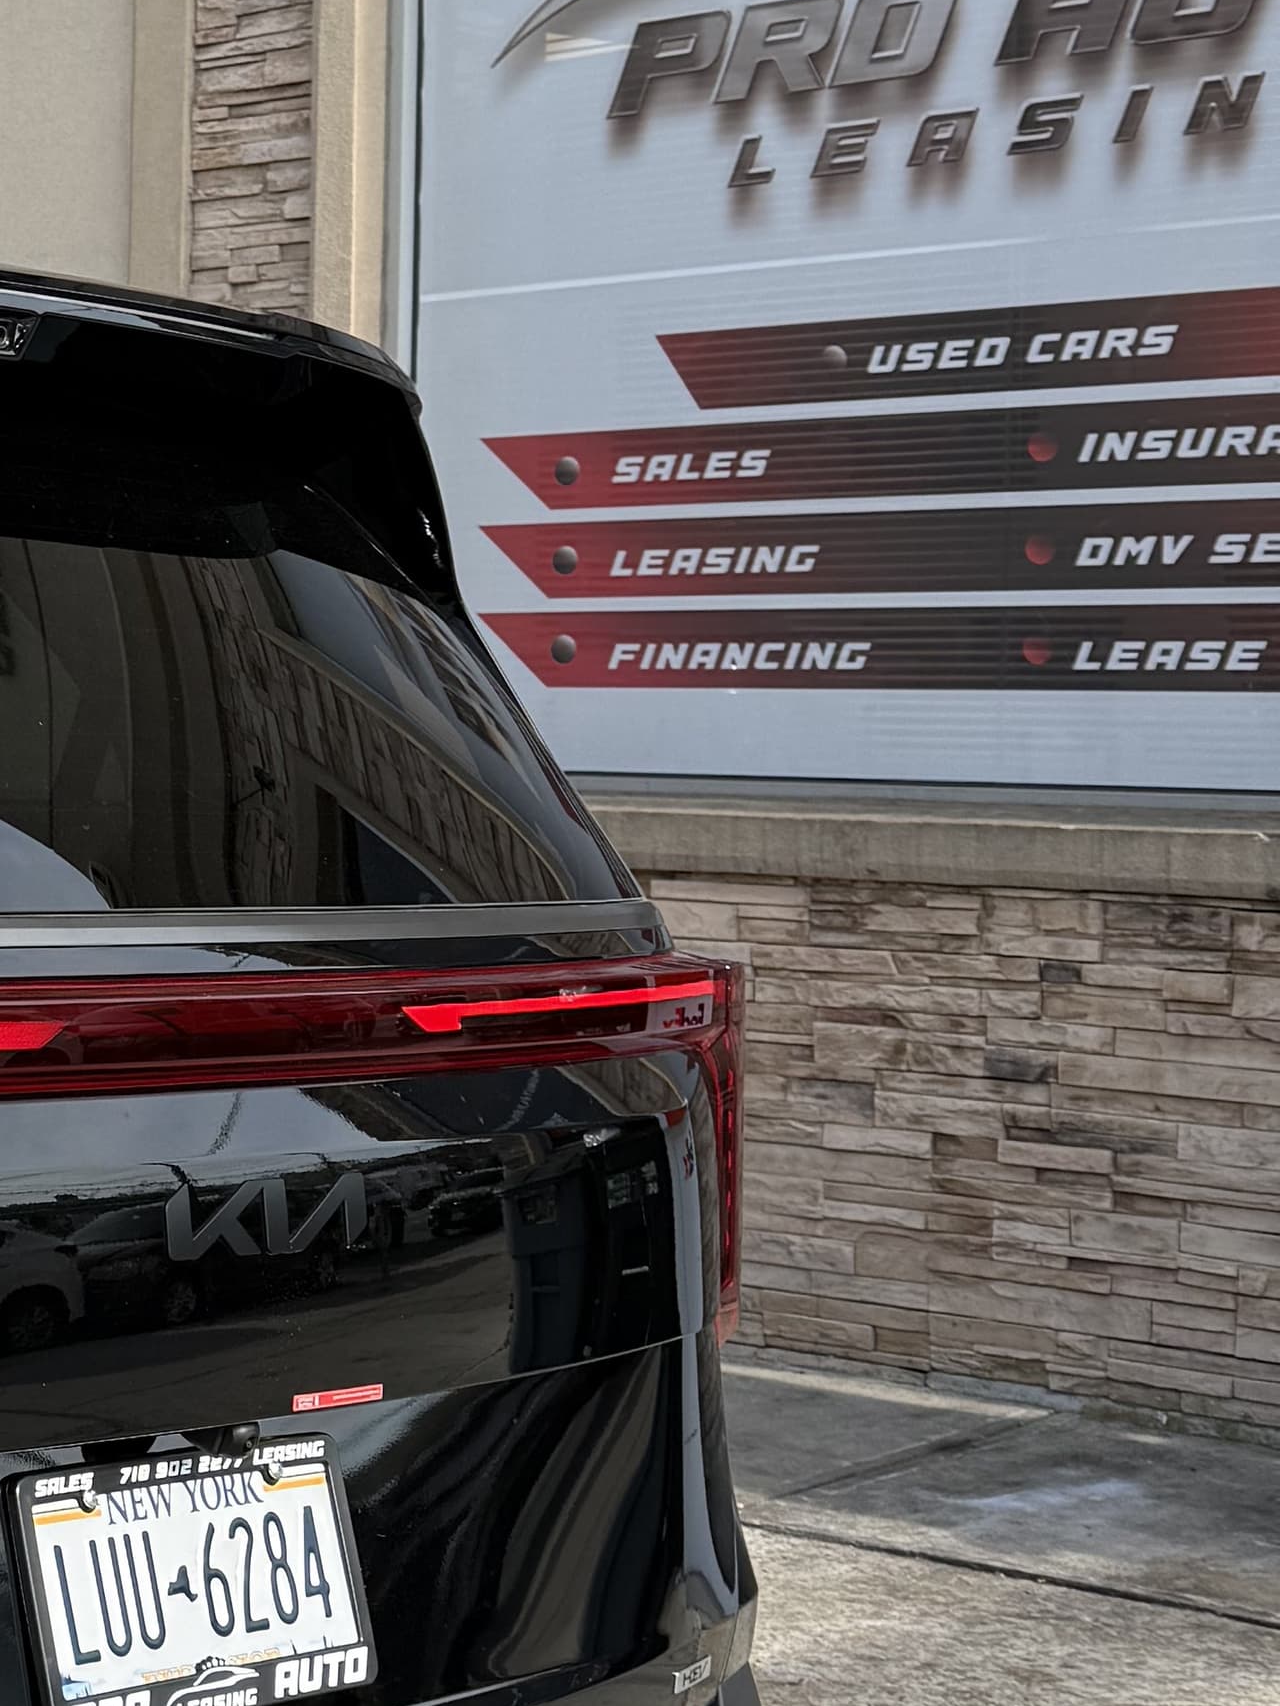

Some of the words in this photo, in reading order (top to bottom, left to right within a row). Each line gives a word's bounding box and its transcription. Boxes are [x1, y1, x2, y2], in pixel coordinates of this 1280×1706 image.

[727, 71, 1264, 188] LEASIN
[866, 336, 1010, 374] USED
[1024, 324, 1180, 364] CARS
[610, 449, 771, 484] SALES
[609, 544, 820, 578] LEASING
[1075, 535, 1194, 567] DMV
[1207, 532, 1280, 565] SE
[607, 641, 872, 671] FINANCING
[1072, 640, 1268, 672] LEASE
[34, 1471, 95, 1498] SALES
[155, 1459, 192, 1480] 902
[253, 1439, 326, 1466] LEASING
[105, 1483, 172, 1525] NEW
[185, 1472, 265, 1512] YORK
[274, 1646, 369, 1699] AUTO
